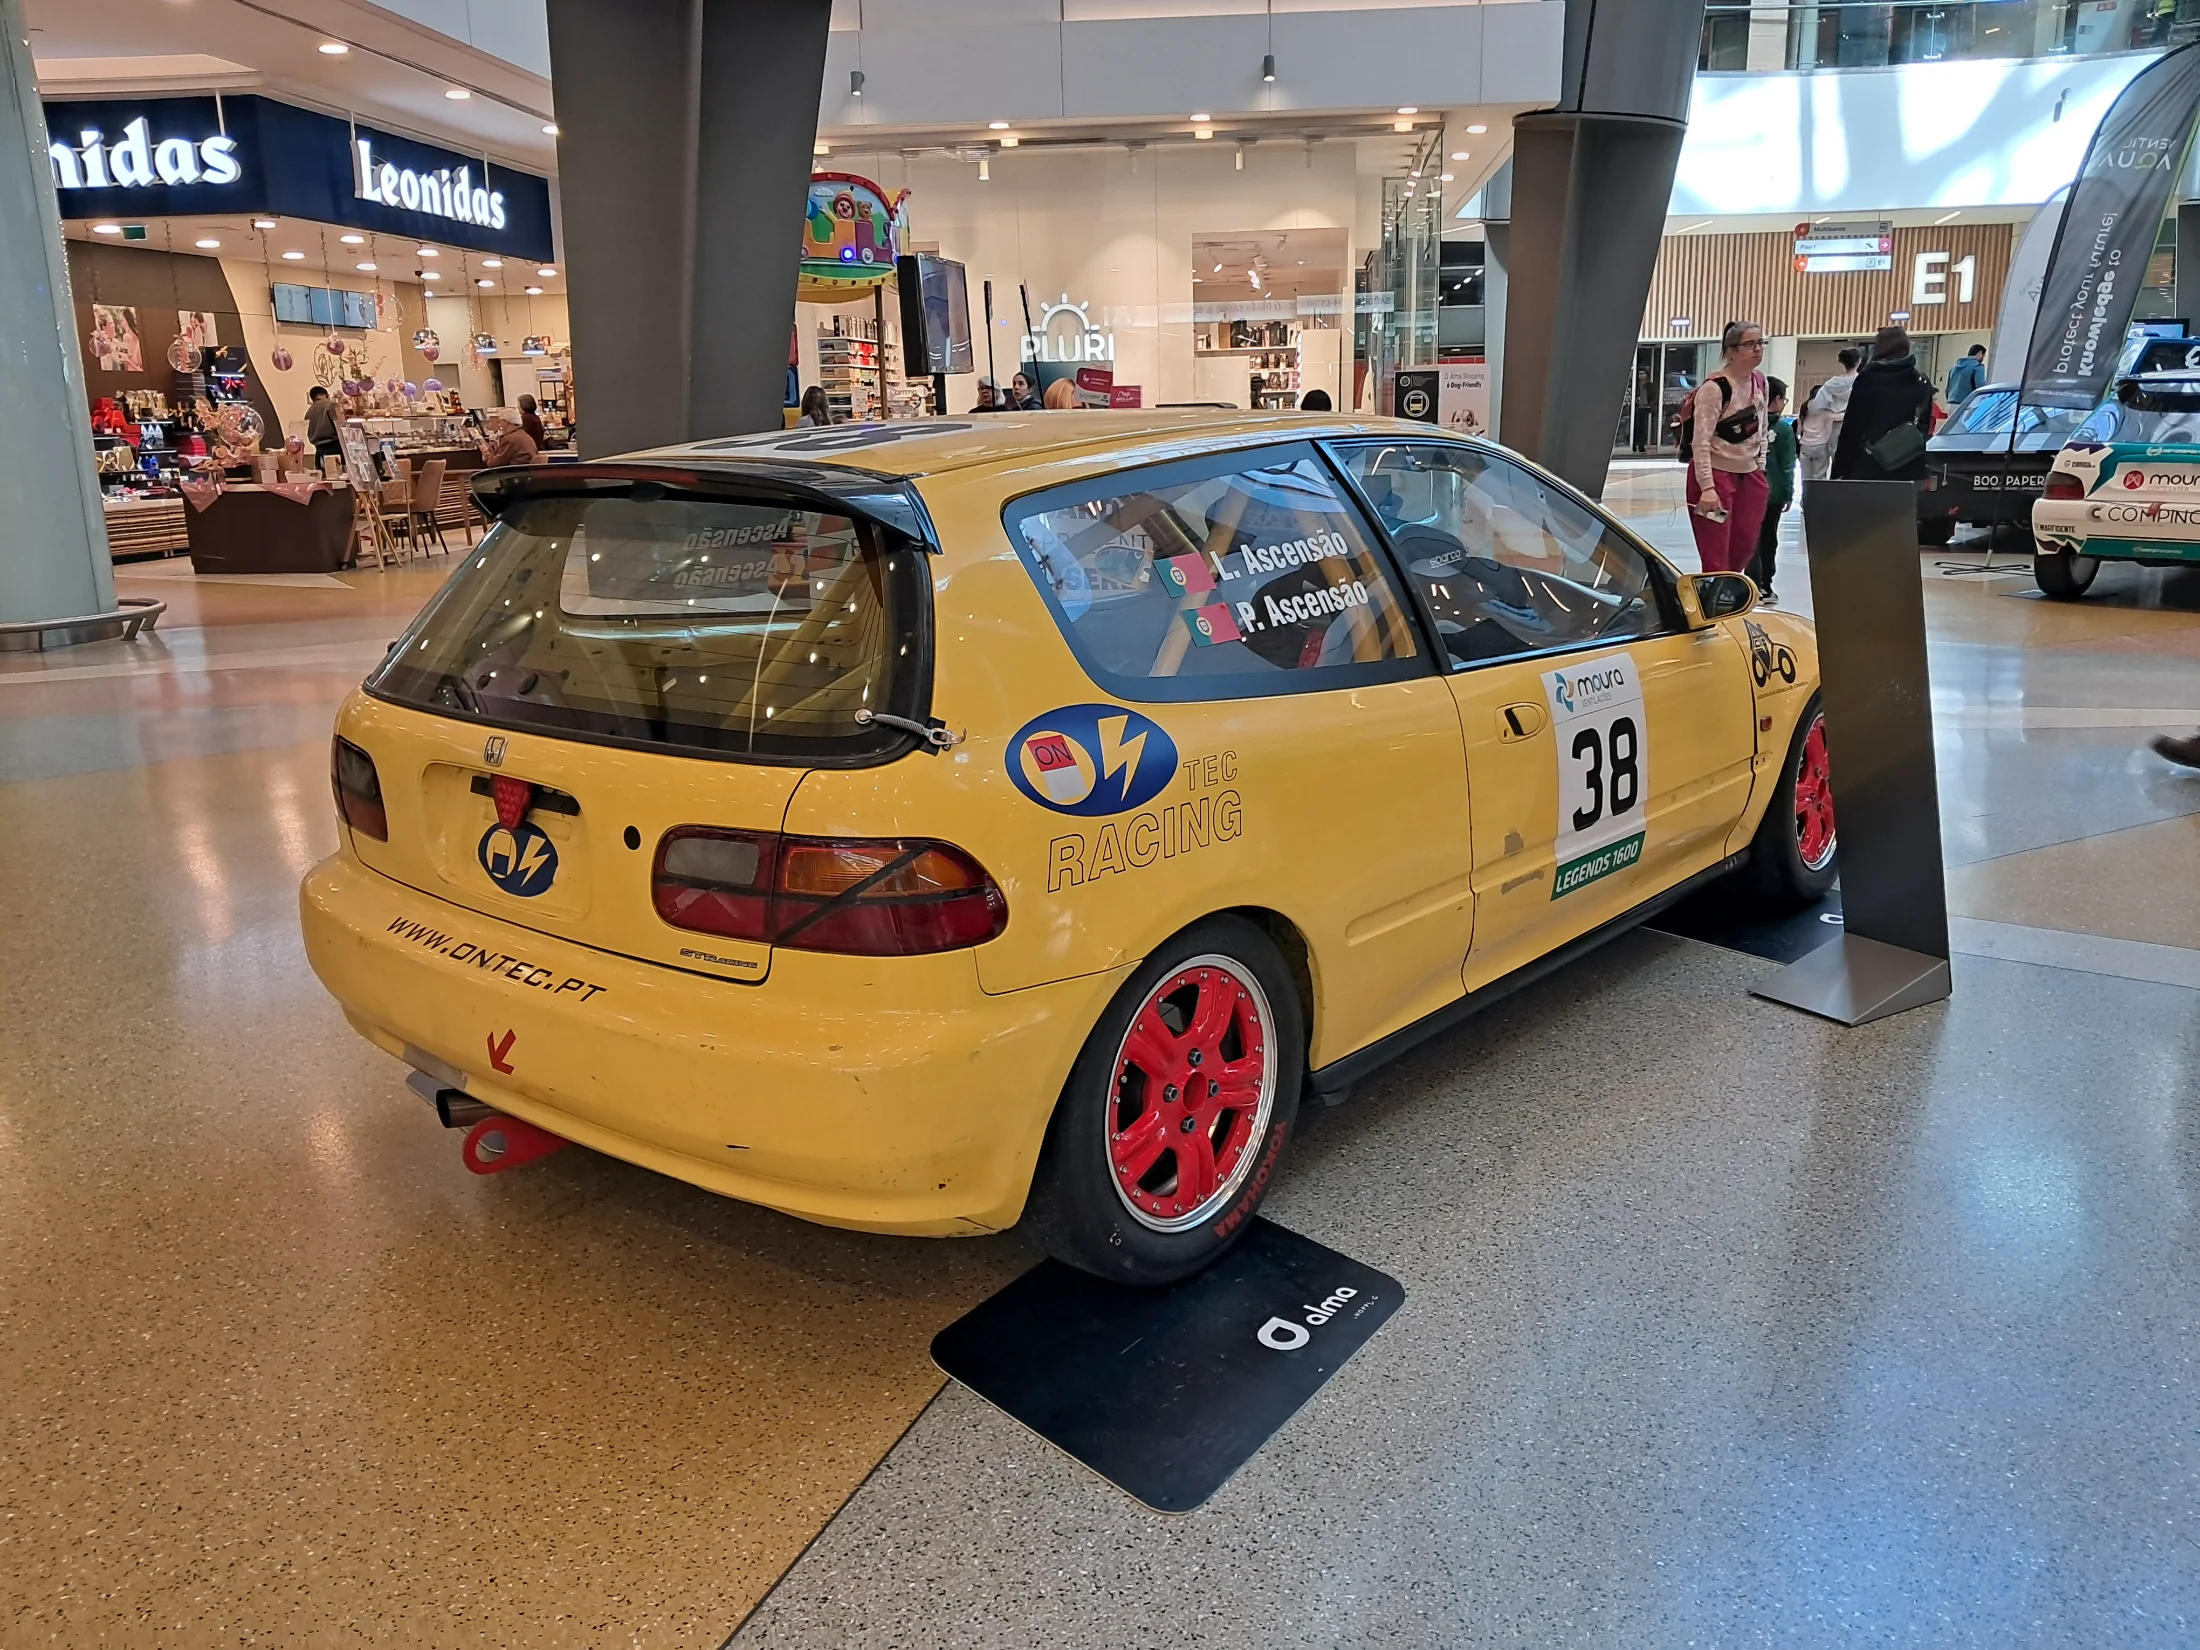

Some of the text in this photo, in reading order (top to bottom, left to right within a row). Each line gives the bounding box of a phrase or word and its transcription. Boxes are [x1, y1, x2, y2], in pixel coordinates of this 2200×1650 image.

[353, 139, 505, 229] Leonidas
[1911, 251, 1976, 305] E1
[1020, 333, 1115, 362] PLURI
[1451, 381, 1483, 389] Dog-Friendly
[1973, 475, 2003, 486] BOO
[1209, 528, 1348, 581] L. Ascensão
[1429, 549, 1462, 567] sparco
[1235, 577, 1369, 633] P. Ascensão
[1577, 668, 1624, 697] moura
[1034, 744, 1071, 767] ON
[1182, 750, 1238, 791] TEC
[1571, 716, 1638, 832] 38
[1047, 789, 1242, 894] RACING
[1556, 840, 1639, 893] LEGENDS 1600
[386, 916, 607, 1003] WWW.ONTEC.PT
[1213, 1121, 1286, 1238] YOKOHAMA
[1302, 1286, 1359, 1326] alma
